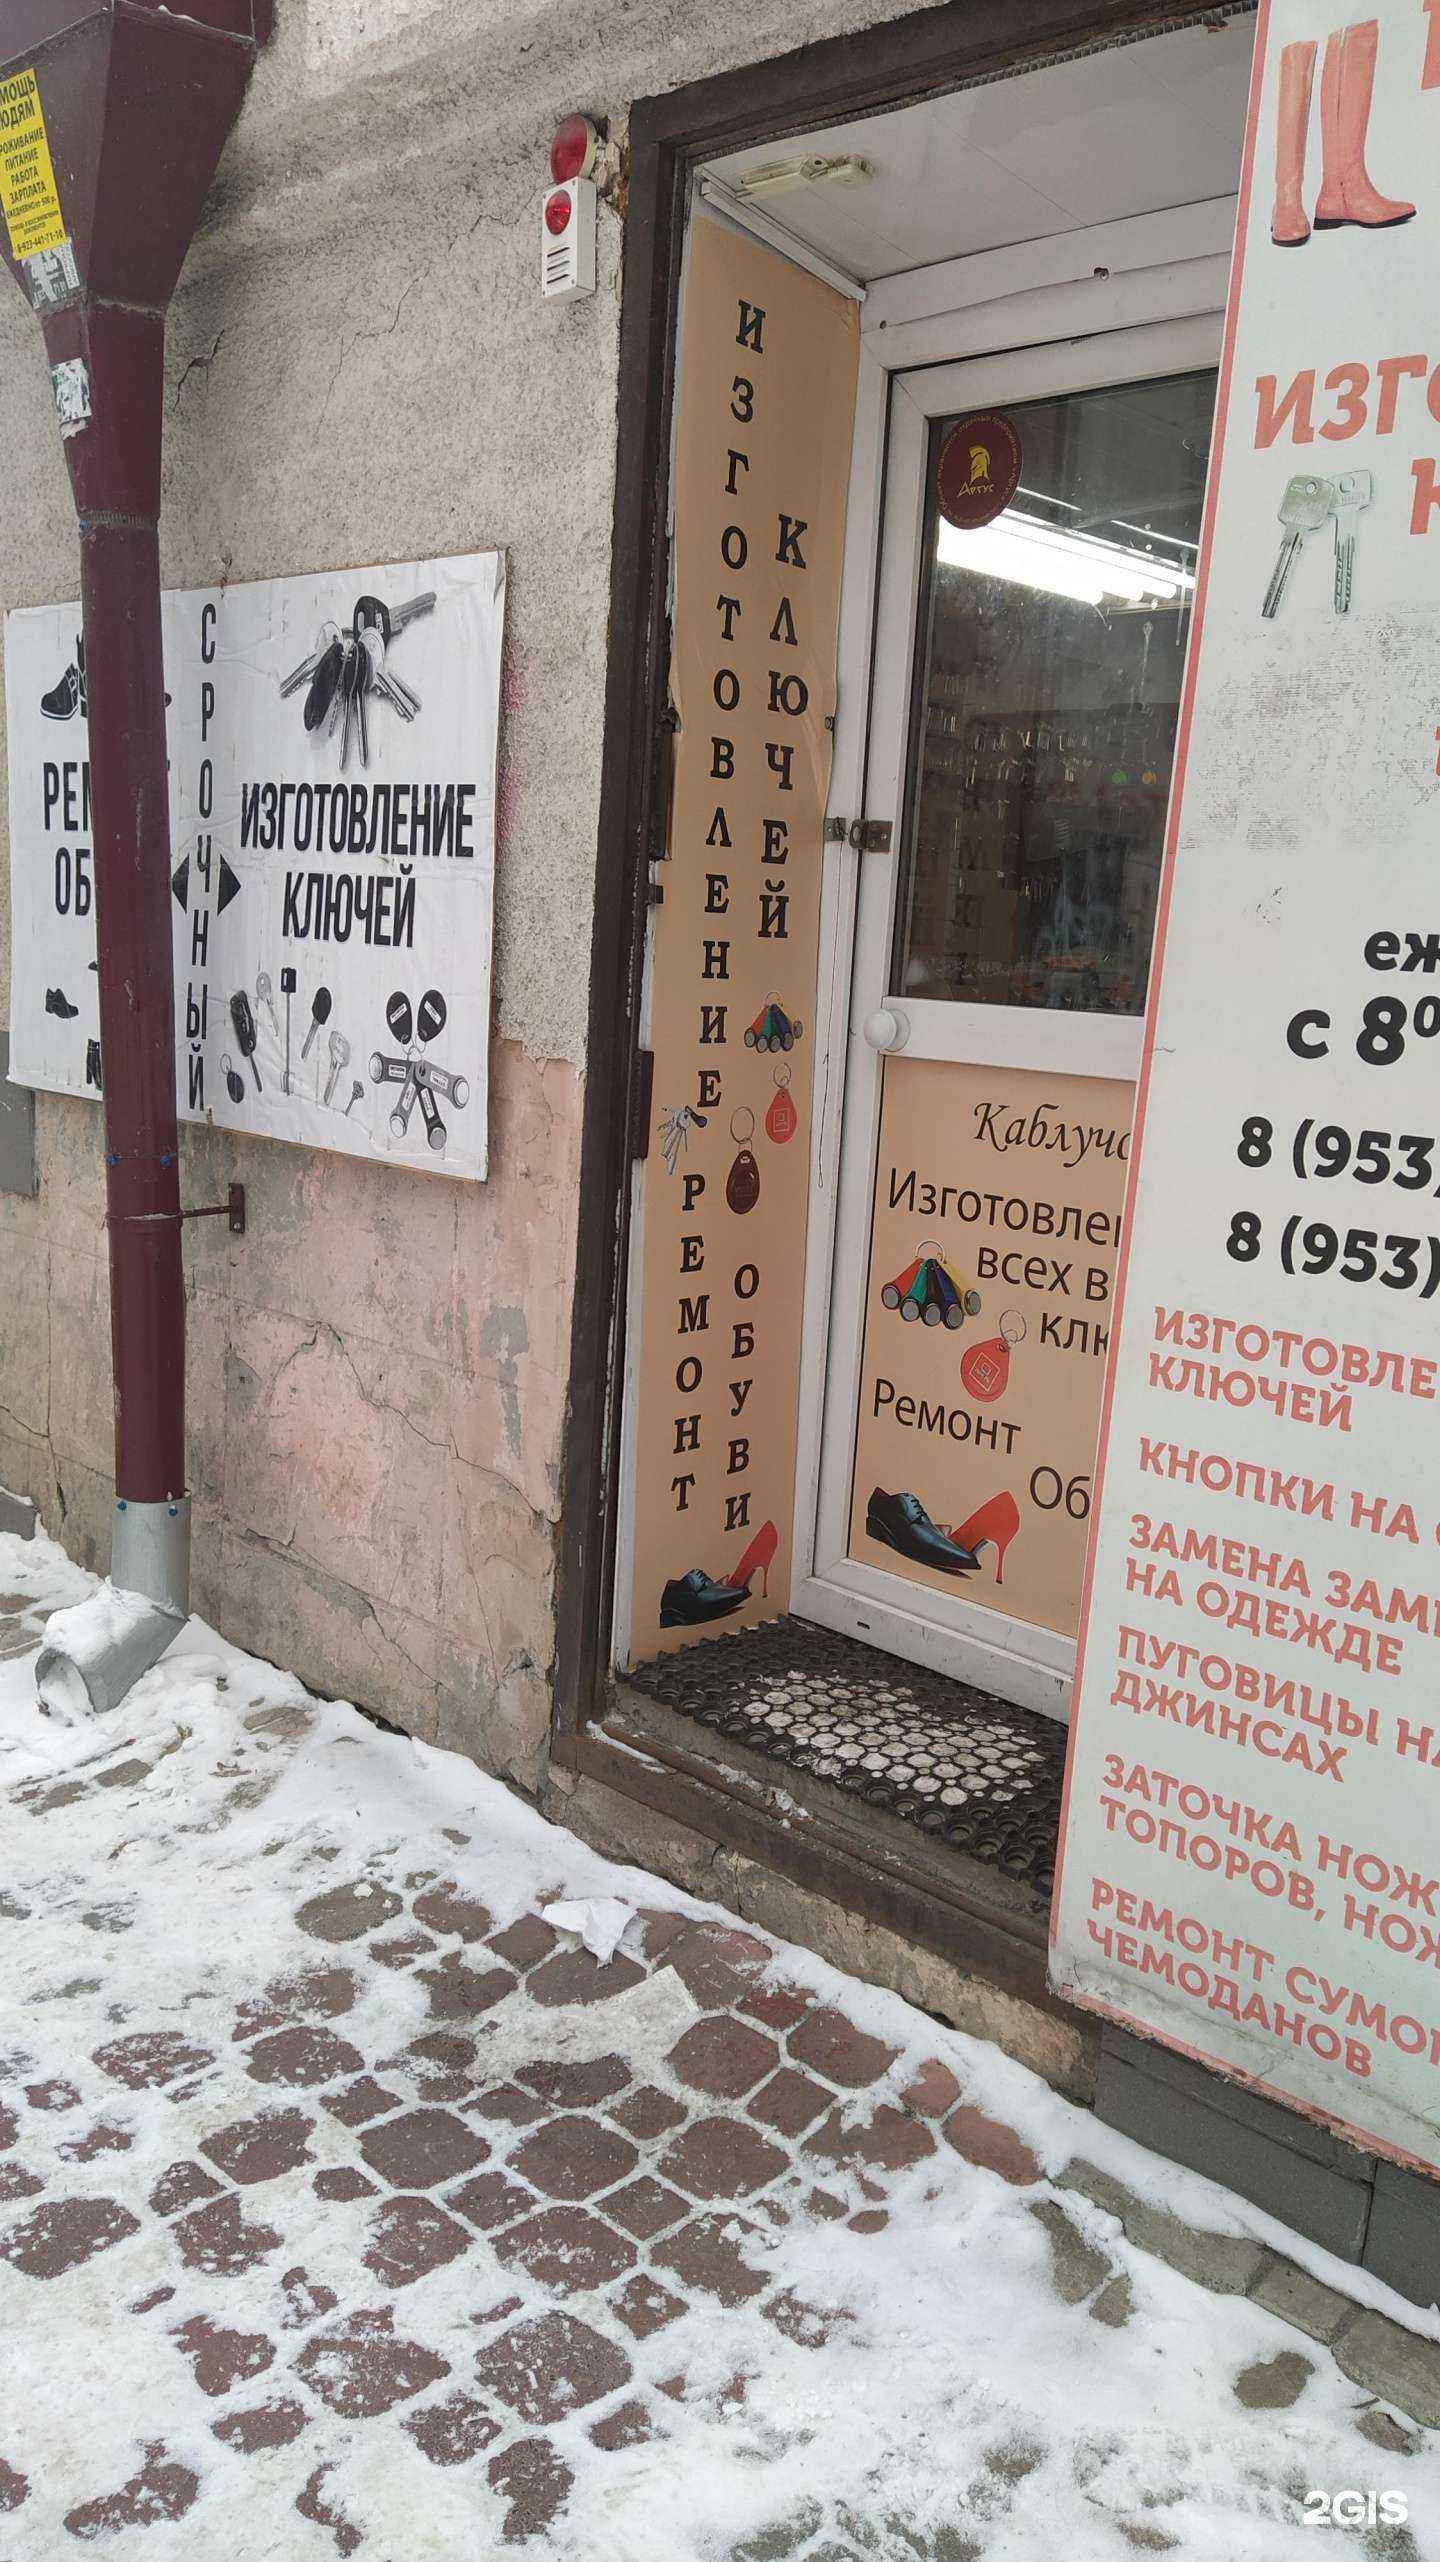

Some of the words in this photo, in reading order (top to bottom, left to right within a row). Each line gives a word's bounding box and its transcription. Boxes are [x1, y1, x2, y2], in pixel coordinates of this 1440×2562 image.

[6, 148, 38, 171] ПИТАНИЕ
[9, 181, 47, 204] ЗАРПЛАТА
[11, 166, 39, 186] РАБОТА
[1254, 355, 1440, 451] ИЗГ
[186, 602, 218, 1112] СРОЧНЫЙ
[240, 782, 476, 858] ИЗГОТОВЛЕНИЕ
[282, 863, 416, 948] КЛЮЧЕЙ
[1286, 1009, 1331, 1060] с
[1237, 1116, 1273, 1168] 8
[977, 1246, 1074, 1296] всех
[1226, 1211, 1262, 1262] 8
[1147, 1353, 1352, 1433] КЛЮЧЕЙ
[1151, 1307, 1439, 1399] ИЗГОТОВЛЕ
[873, 1378, 1022, 1455] Ремонт
[1140, 1435, 1335, 1521] КНОПКИ
[1348, 1491, 1420, 1543] НА
[1124, 1555, 1183, 1606] НА
[1195, 1580, 1404, 1676] ОДЕЖДЕ
[1129, 1513, 1313, 1597] ЗАМЕНА
[1324, 1567, 1440, 1639] ЗАМ
[1109, 1670, 1348, 1781] ДЖИНСАХ
[1118, 1626, 1380, 1745] ПУГОВИЦЫ
[1099, 1795, 1325, 1920] ТОПОРОВ,
[1100, 1753, 1301, 1860] ЗАТОЧКА
[1317, 1835, 1439, 1917] НОЖ
[1087, 1878, 1277, 1980] РЕМОНТ
[1286, 1967, 1440, 2066] СУМО
[1087, 1918, 1372, 2077] ЧЕМОДАНОВ
